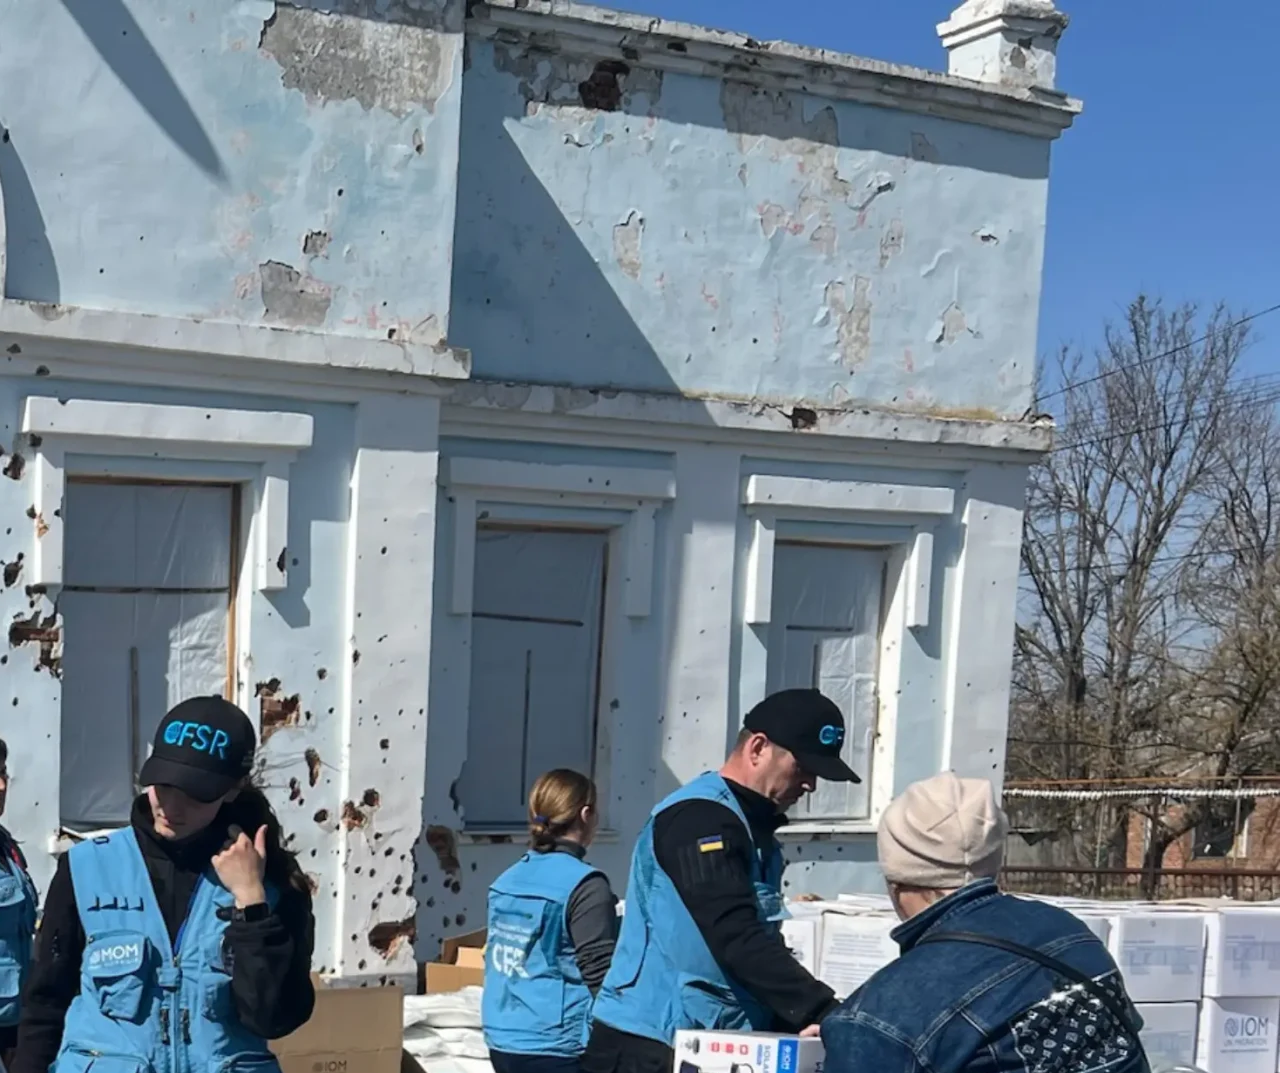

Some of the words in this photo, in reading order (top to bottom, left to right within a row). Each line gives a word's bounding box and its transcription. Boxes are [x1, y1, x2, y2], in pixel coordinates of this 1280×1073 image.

[164, 720, 228, 760] CFSR
[1241, 1016, 1269, 1037] IOM
[324, 1059, 347, 1073] IOM
